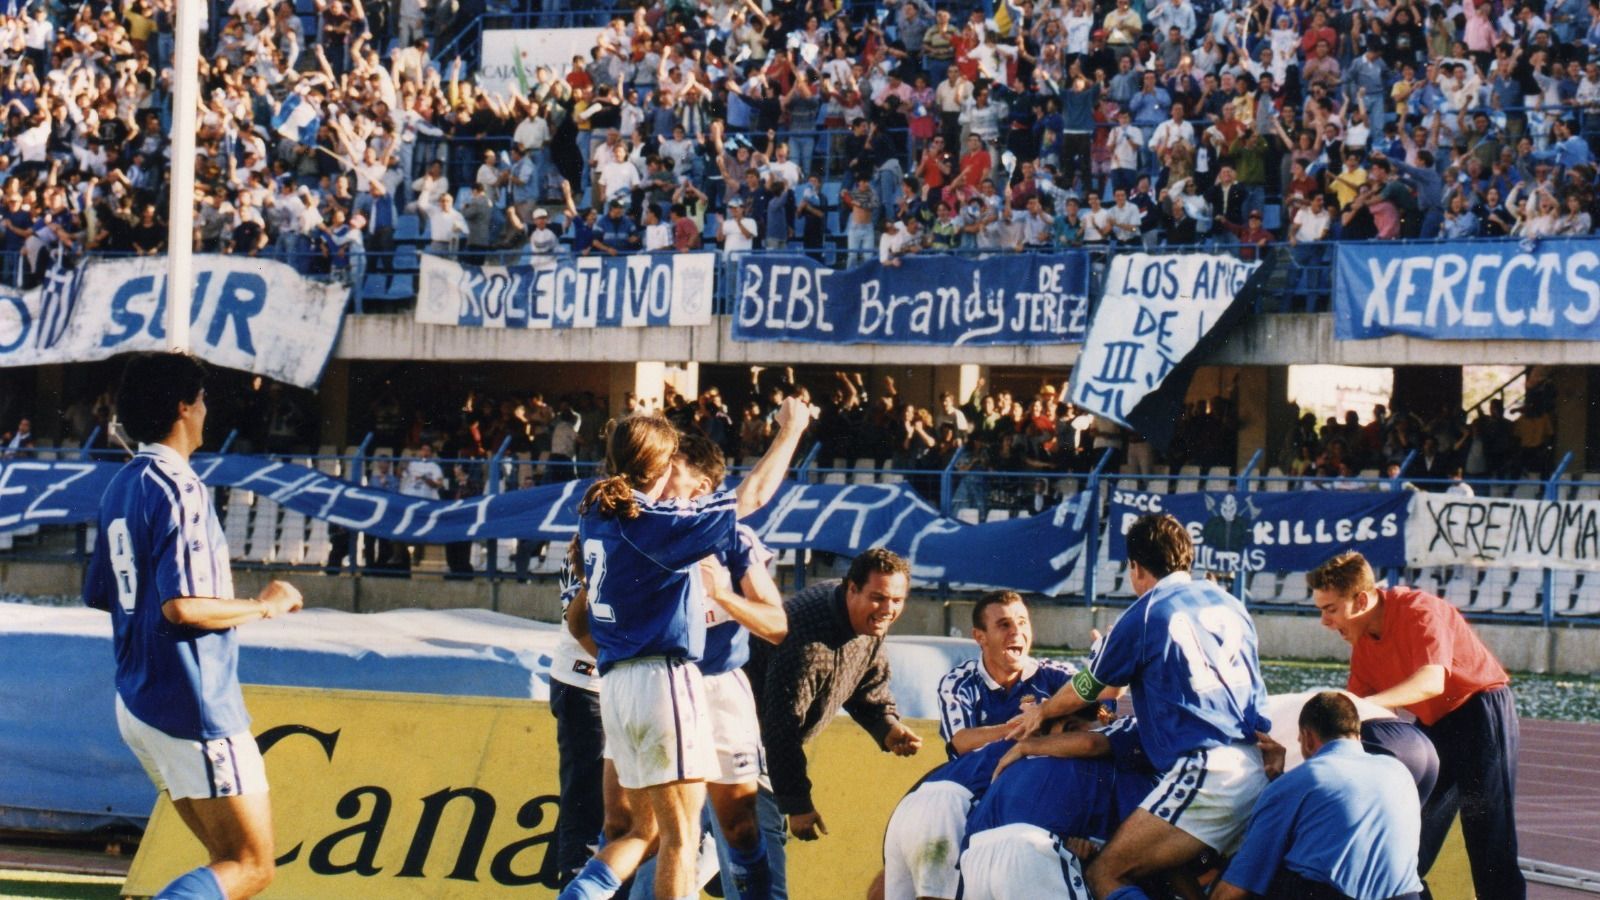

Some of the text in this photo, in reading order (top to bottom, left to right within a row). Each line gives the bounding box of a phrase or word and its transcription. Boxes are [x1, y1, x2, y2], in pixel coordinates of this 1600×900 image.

[460, 263, 671, 321] KOLECTIVO
[1039, 263, 1065, 293] DE
[1121, 257, 1180, 300] LOS
[1362, 250, 1600, 328] XERECIS
[739, 264, 1005, 346] BEBE Brandy
[1010, 292, 1088, 333] JEREZ
[1133, 305, 1179, 353] DE
[1252, 512, 1398, 546] KILLERS
[583, 538, 617, 623] 2
[1194, 546, 1266, 572] ULTRAS
[1168, 605, 1251, 692] 12
